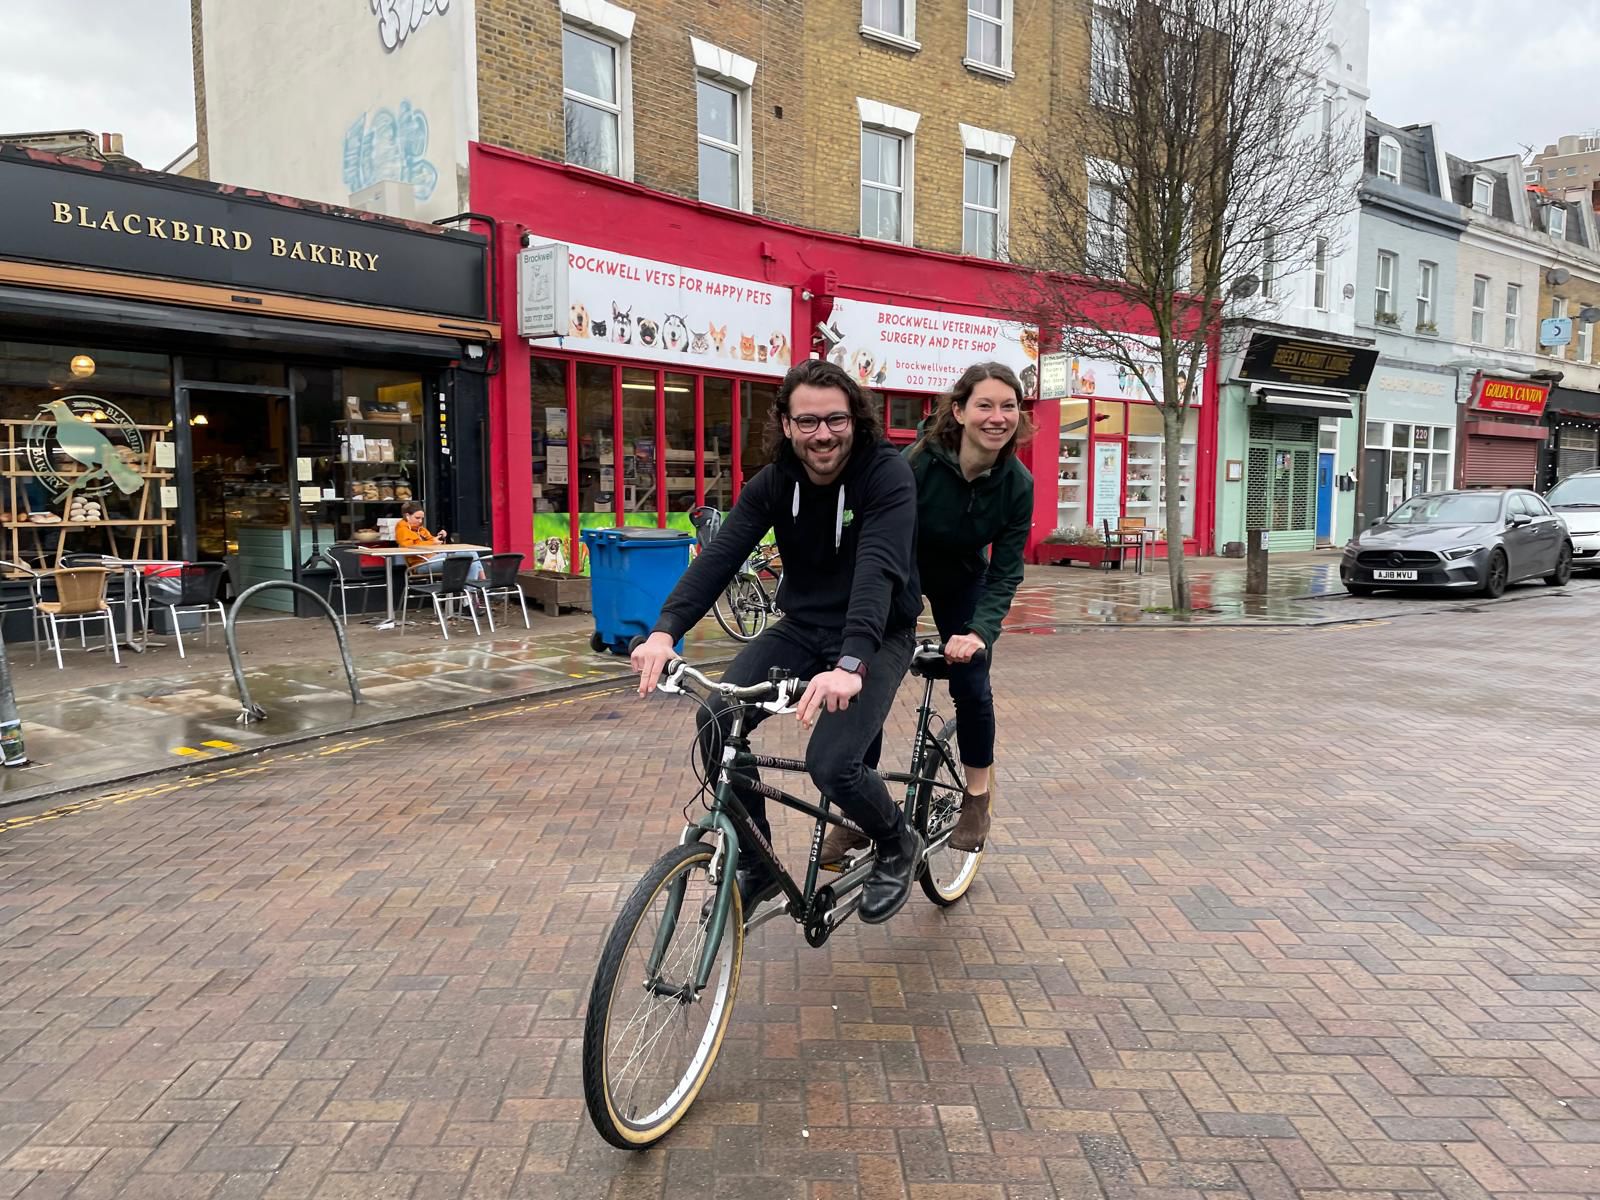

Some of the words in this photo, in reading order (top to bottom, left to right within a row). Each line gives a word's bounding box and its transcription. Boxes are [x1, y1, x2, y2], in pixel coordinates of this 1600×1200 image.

[52, 201, 252, 251] BLACKBIRD
[270, 237, 379, 272] BAKERY
[523, 251, 553, 264] Brockwell
[568, 253, 640, 281] ROCKWELL
[645, 269, 675, 287] VETS
[678, 276, 703, 292] FOR
[706, 281, 743, 302] HAPPY
[746, 289, 772, 305] PETS
[877, 312, 939, 331] BROCKWELL
[942, 320, 999, 338] VETERINARY
[880, 330, 926, 347] SURGERY
[928, 336, 949, 348] AND
[952, 339, 969, 350] PET
[971, 341, 997, 352] SHOP
[906, 375, 924, 385] 020
[928, 377, 947, 387] 7737
[1485, 383, 1515, 400] GOLDEN
[1515, 387, 1542, 404] CANTON
[1415, 429, 1428, 440] 220
[32, 446, 64, 490] BAKERY
[1378, 571, 1395, 579] AJ18
[1396, 571, 1413, 579] MVU
[755, 755, 774, 766] TWO
[750, 780, 782, 801] TANDEM
[746, 816, 785, 873] AMMACO
[810, 824, 821, 862] AMMACO
